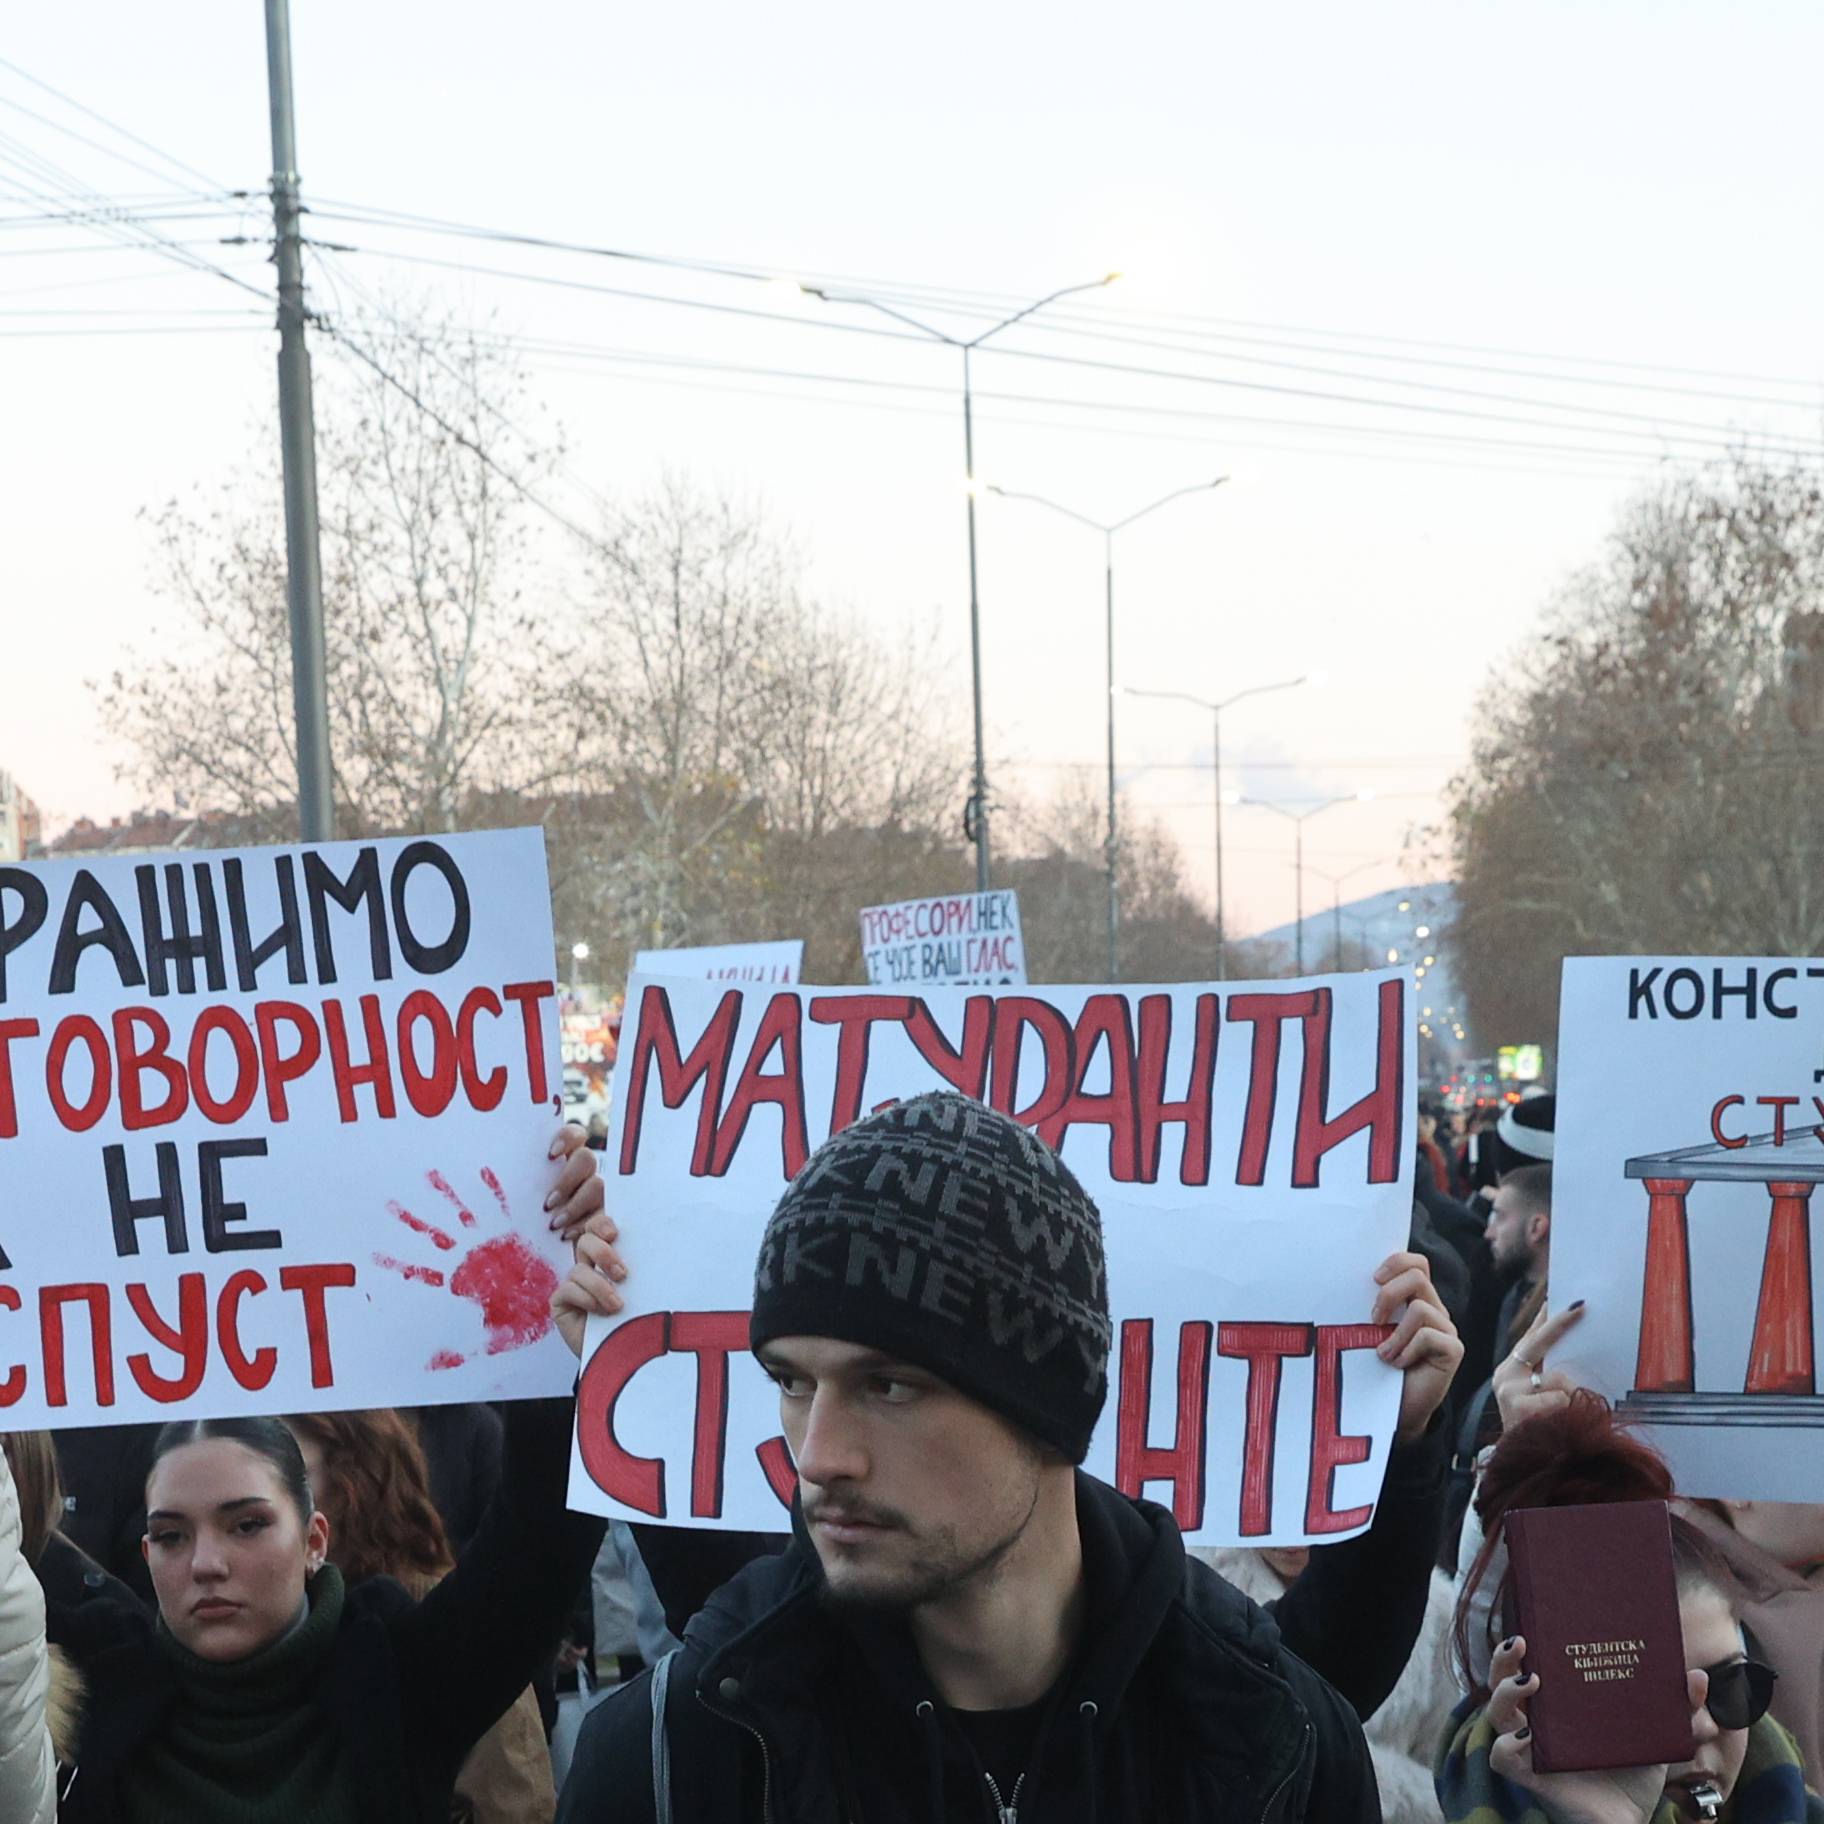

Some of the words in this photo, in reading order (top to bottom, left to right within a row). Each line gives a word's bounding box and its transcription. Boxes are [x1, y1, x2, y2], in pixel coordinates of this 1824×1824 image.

[921, 938, 963, 979] ВАШ
[619, 978, 1407, 1189] МАТУРАНТИ
[102, 1137, 283, 1257] НЕ
[576, 1310, 1397, 1537] СТНТЕ
[1565, 1639, 1646, 1656] СТУДЕНТСКА
[1584, 1668, 1635, 1682] ИНДЕКС
